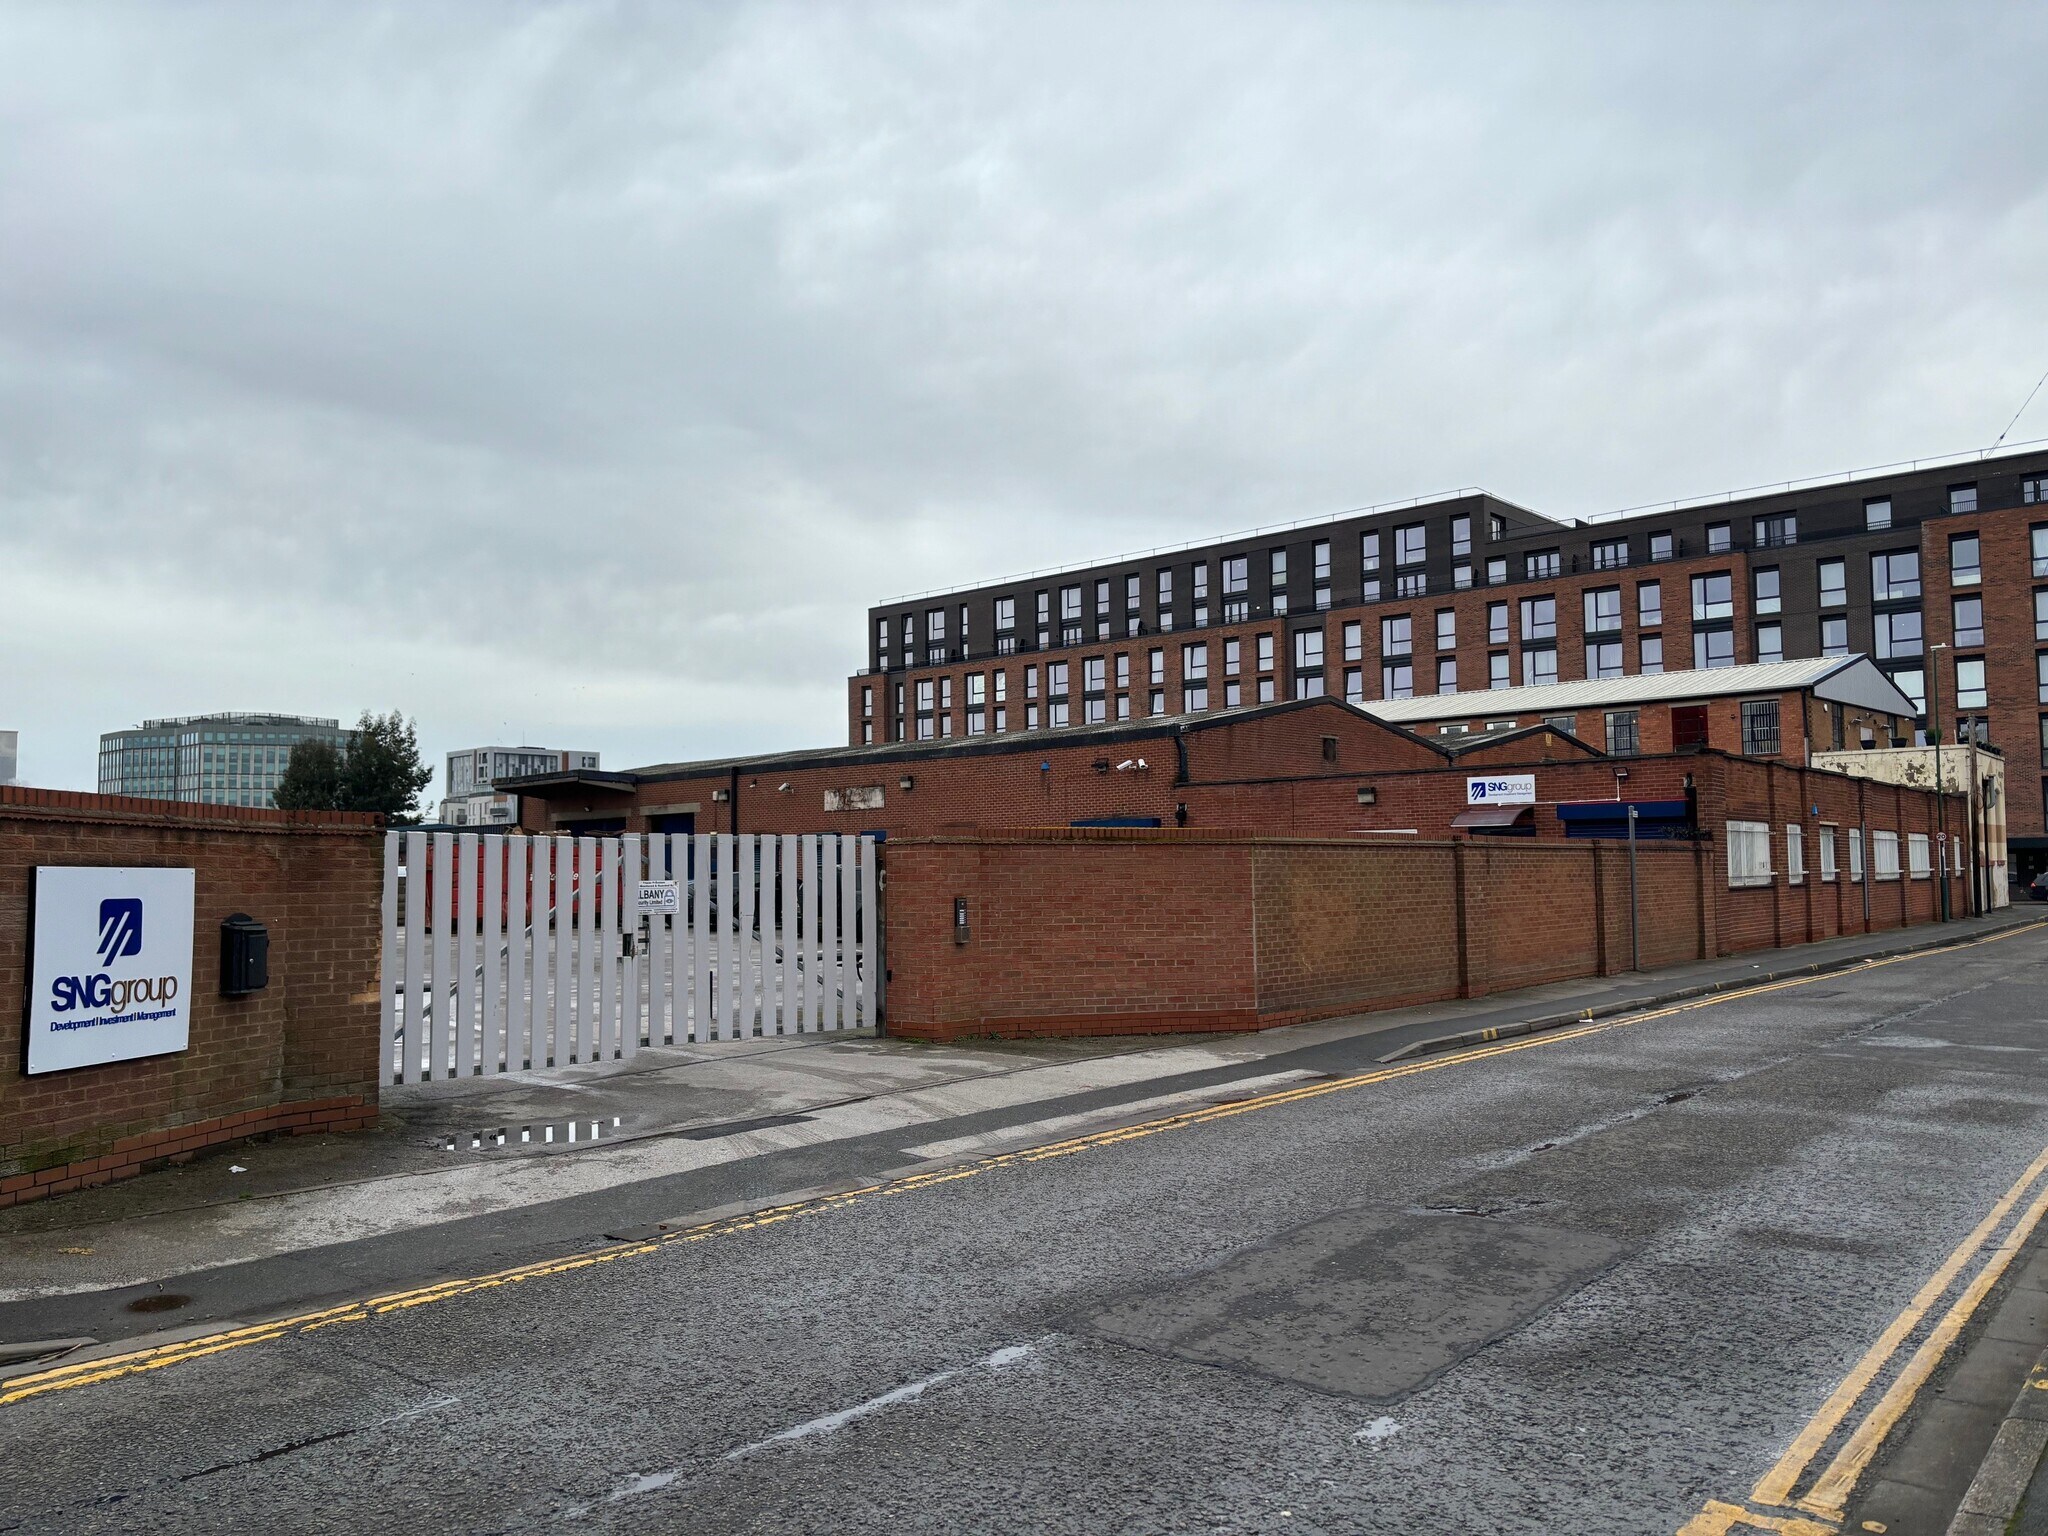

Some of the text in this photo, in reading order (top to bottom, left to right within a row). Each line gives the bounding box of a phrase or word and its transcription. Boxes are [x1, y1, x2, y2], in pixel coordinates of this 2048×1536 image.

[1488, 782, 1532, 793] SNGgroup
[638, 889, 665, 899] LBANY
[51, 973, 177, 1014] SNGgroup
[51, 1008, 176, 1031] Development Investment Management
